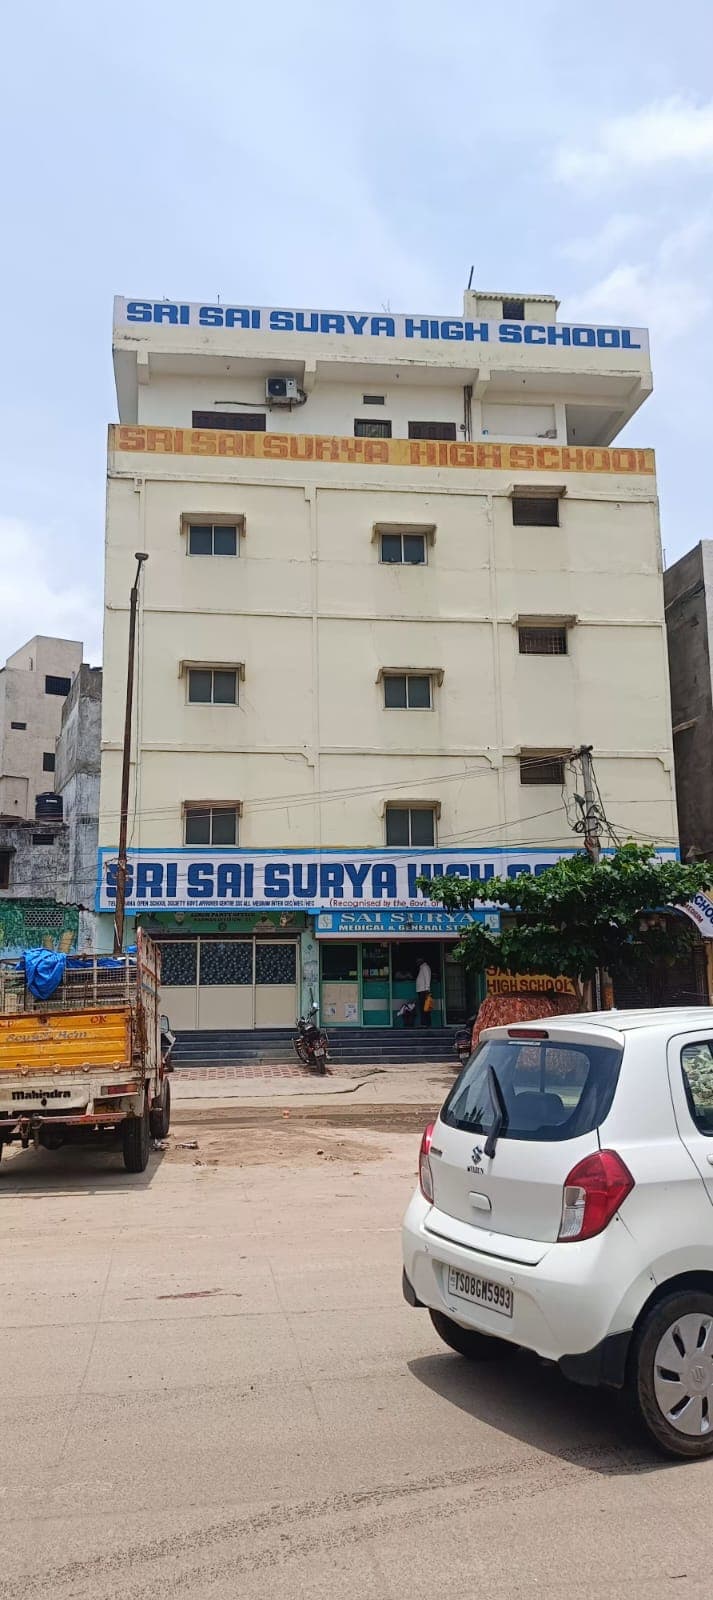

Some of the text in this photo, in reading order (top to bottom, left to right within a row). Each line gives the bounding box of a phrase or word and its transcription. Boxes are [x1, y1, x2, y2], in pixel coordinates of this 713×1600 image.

[126, 302, 641, 349] SRI SAI SURYA HIGH SCHOOL
[118, 427, 655, 471] SRI SAI SURYA HIGH SCHOOL
[106, 863, 178, 898] SRI
[187, 863, 254, 898] SAI
[264, 863, 397, 898] SURYA
[384, 899, 391, 908] by
[393, 899, 407, 907] the
[340, 912, 475, 923] SAI SURYA
[487, 978, 572, 994] HIGH SCHOOL
[90, 1015, 107, 1024] OK
[11, 1089, 71, 1100] Mahindra
